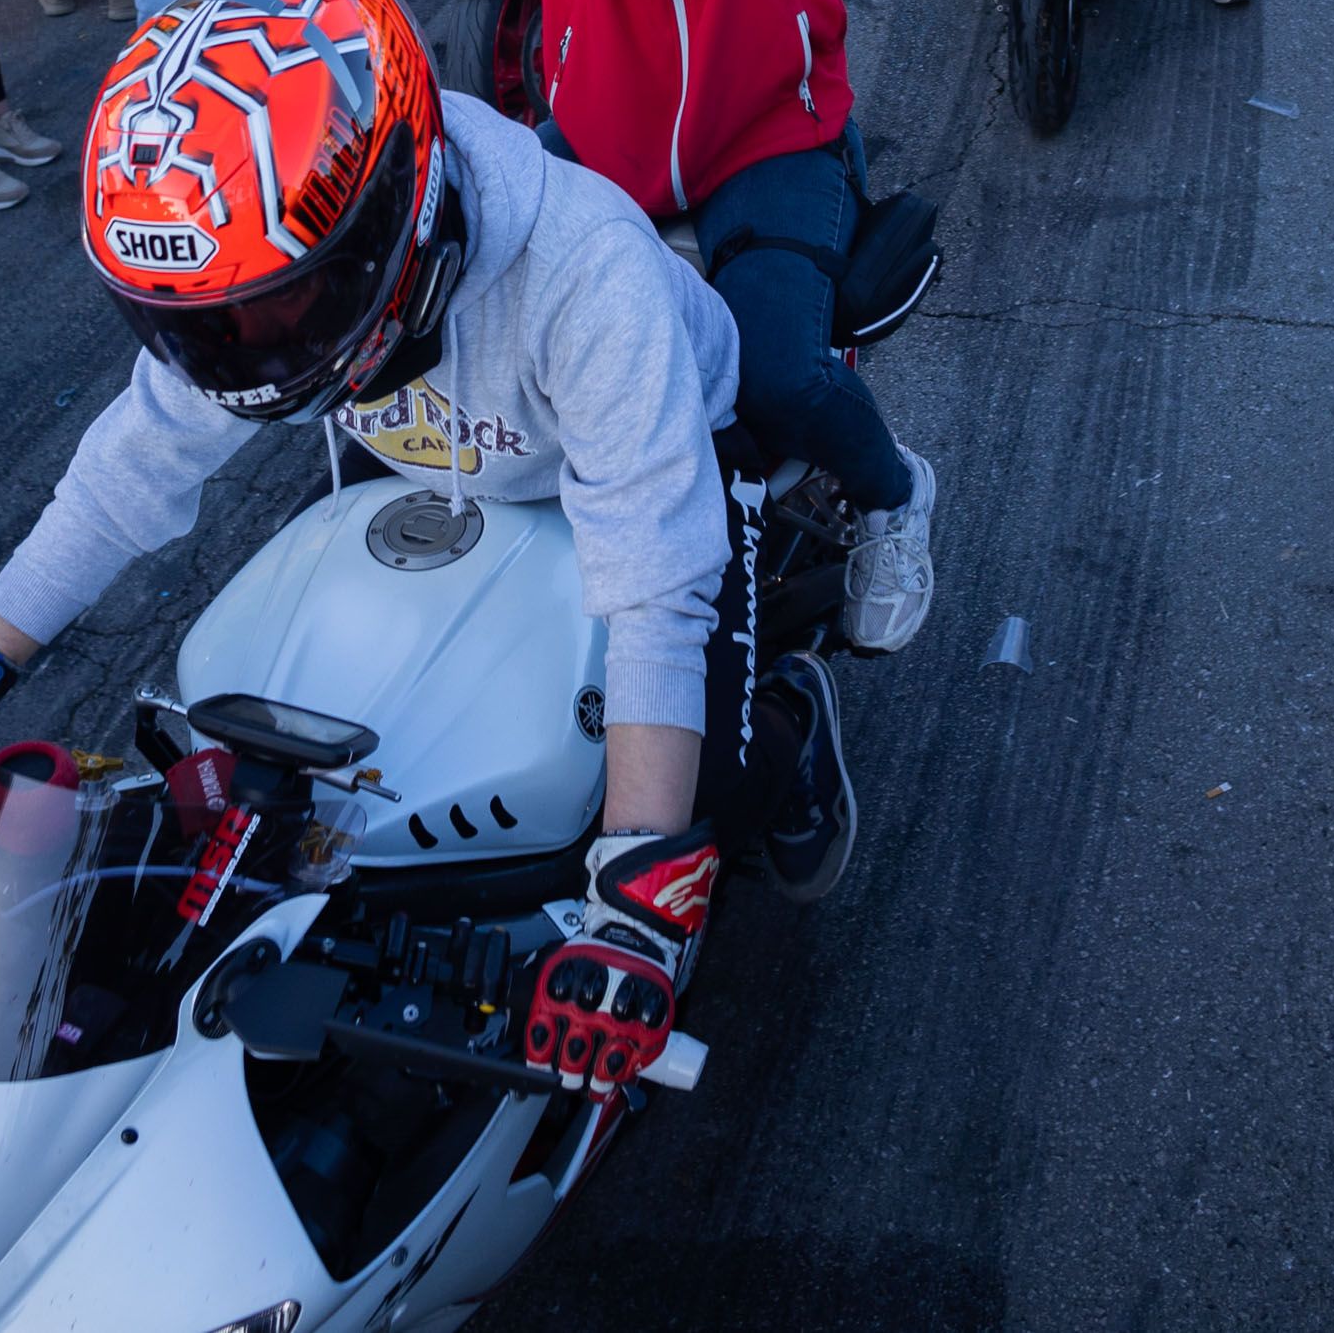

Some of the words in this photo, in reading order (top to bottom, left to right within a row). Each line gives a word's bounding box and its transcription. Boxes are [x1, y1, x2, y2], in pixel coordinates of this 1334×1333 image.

[422, 151, 441, 229] SHOEI
[115, 229, 199, 262] SHOEI
[189, 383, 281, 406] ALFER
[336, 387, 414, 436] ard
[402, 436, 451, 453] CAF
[176, 805, 252, 924] MSR
